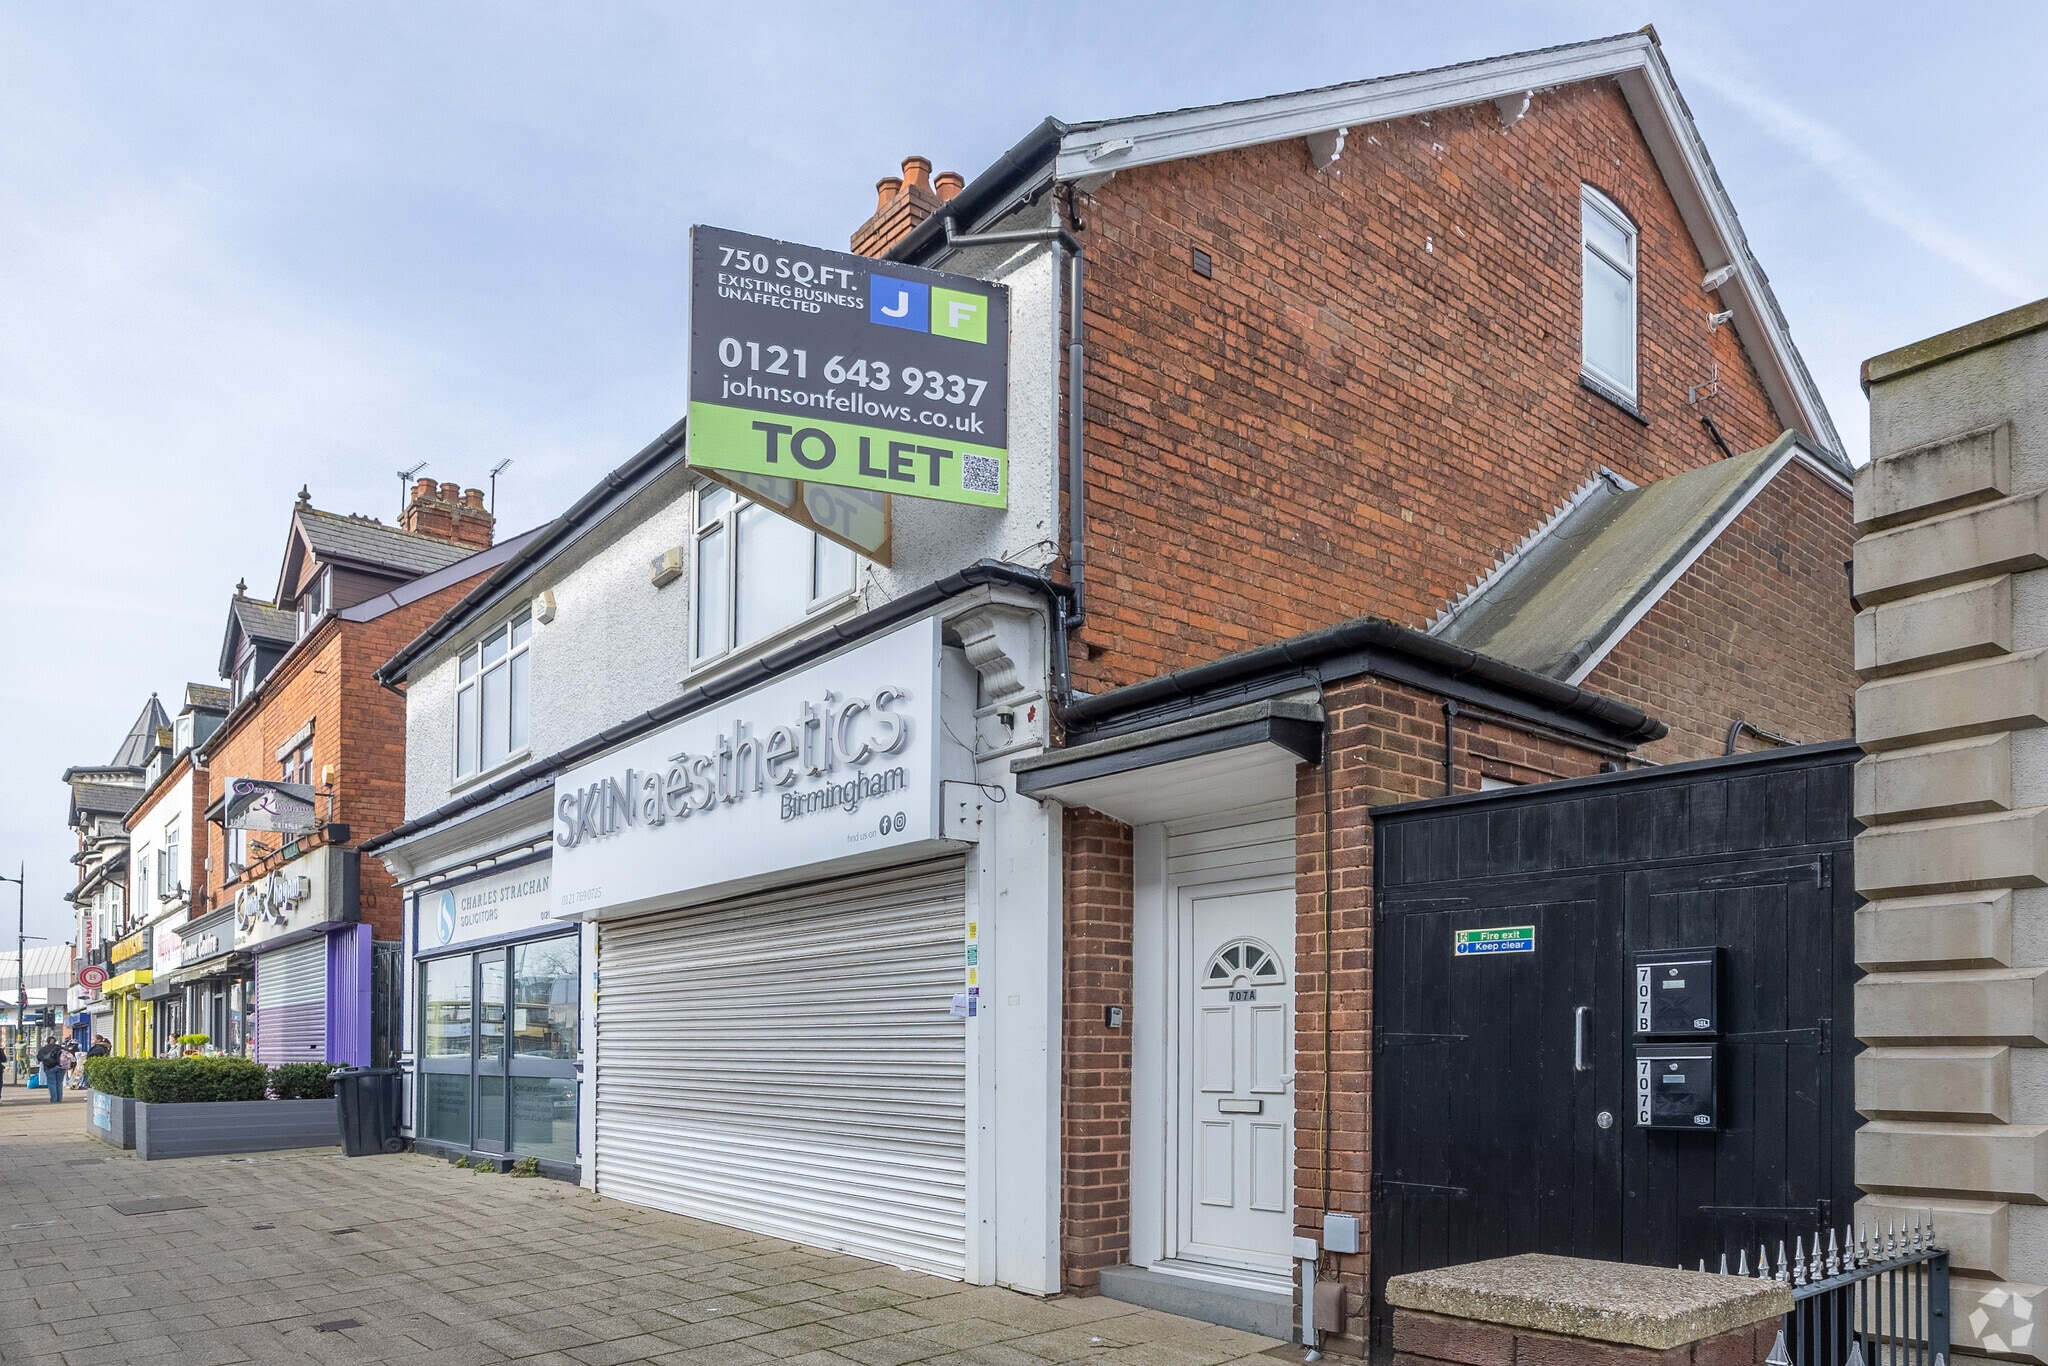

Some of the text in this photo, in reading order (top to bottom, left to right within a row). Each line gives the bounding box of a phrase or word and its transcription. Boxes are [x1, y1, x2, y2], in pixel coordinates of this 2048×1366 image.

[718, 245, 858, 291] 750 SQ.FT.
[718, 273, 865, 310] EXISTING BUSINESS
[718, 286, 822, 314] UNAFFECTED
[880, 291, 977, 328] J F
[718, 337, 989, 407] 0121 643 9337
[721, 374, 985, 435] johnsonfellows.co.uk
[752, 420, 954, 487] TO LET
[780, 766, 905, 820] Birmingham
[461, 876, 550, 912] CHARLES STRACHAN
[460, 908, 498, 928] SOLICITORS
[1481, 930, 1520, 941] Fire exit
[1475, 941, 1525, 952] Keep clear
[1229, 990, 1255, 1001] 707A
